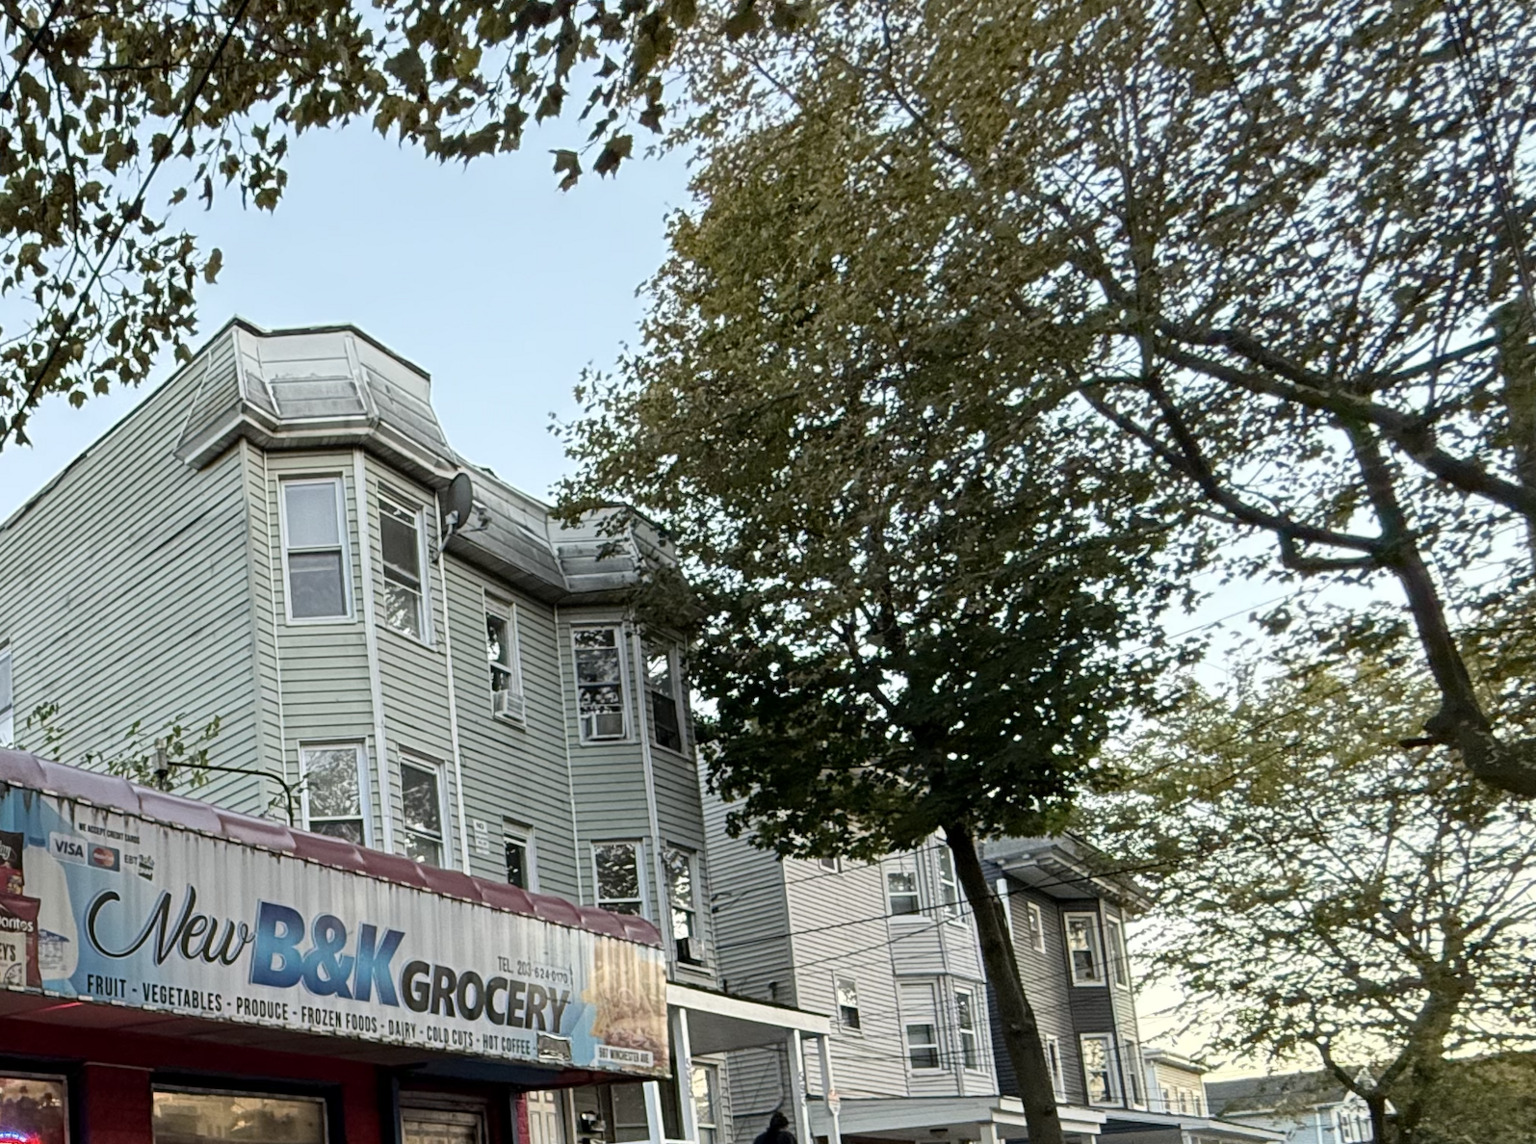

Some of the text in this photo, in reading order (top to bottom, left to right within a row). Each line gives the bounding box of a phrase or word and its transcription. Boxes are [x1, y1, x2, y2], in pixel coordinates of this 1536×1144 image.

[54, 839, 84, 858] VISA
[86, 883, 256, 968] New
[249, 900, 406, 1008] B&K
[401, 960, 571, 1035] GROCERY
[87, 973, 531, 1055] FRUIT VEGETABLES PRODUCE FROZEN FOODS DAIRY COLD CUTS HOT COFFEE
